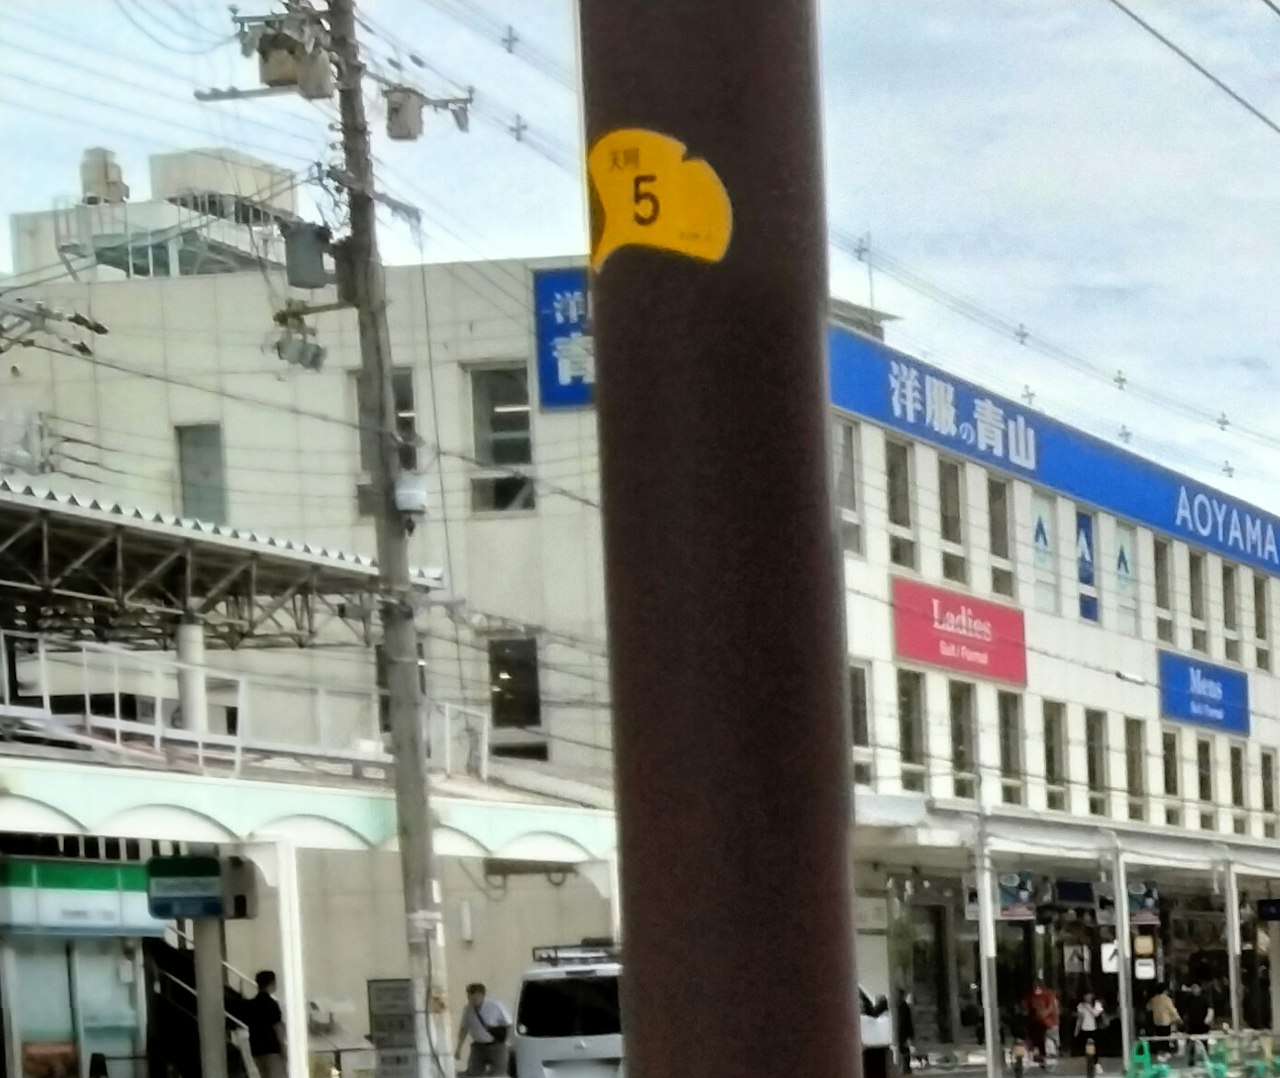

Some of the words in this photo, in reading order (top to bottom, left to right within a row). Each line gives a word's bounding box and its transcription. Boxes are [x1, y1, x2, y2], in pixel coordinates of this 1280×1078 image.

[633, 174, 660, 227] 5
[888, 360, 1036, 470] 洋服の青山
[1175, 485, 1279, 565] AOYAMA
[931, 598, 992, 642] Ladies
[1189, 666, 1223, 701] Mens
